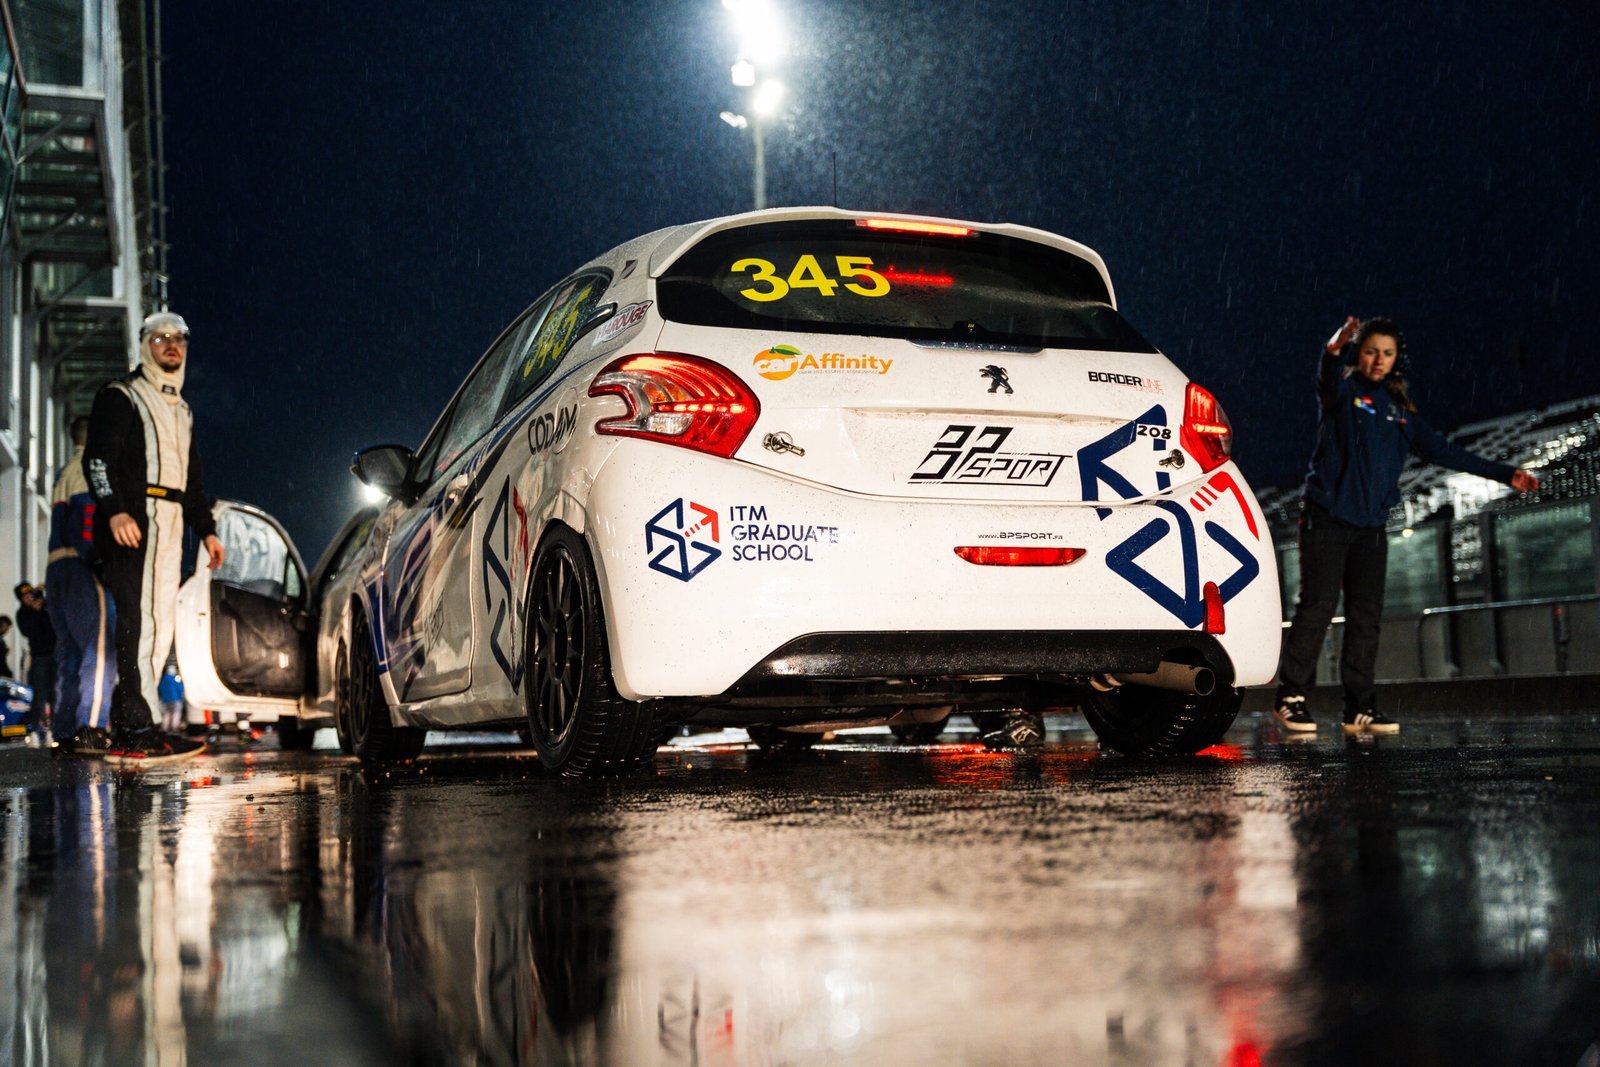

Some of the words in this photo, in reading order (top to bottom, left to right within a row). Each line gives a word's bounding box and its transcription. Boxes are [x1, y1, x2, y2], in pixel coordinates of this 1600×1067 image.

[730, 254, 891, 302] 345
[799, 353, 893, 375] Affinity
[527, 403, 578, 455] CODAM
[1137, 425, 1172, 439] 208
[957, 452, 1073, 487] SPORT
[730, 505, 768, 521] ITM
[731, 524, 839, 544] GRADUATE
[732, 544, 814, 562] SCHOOL
